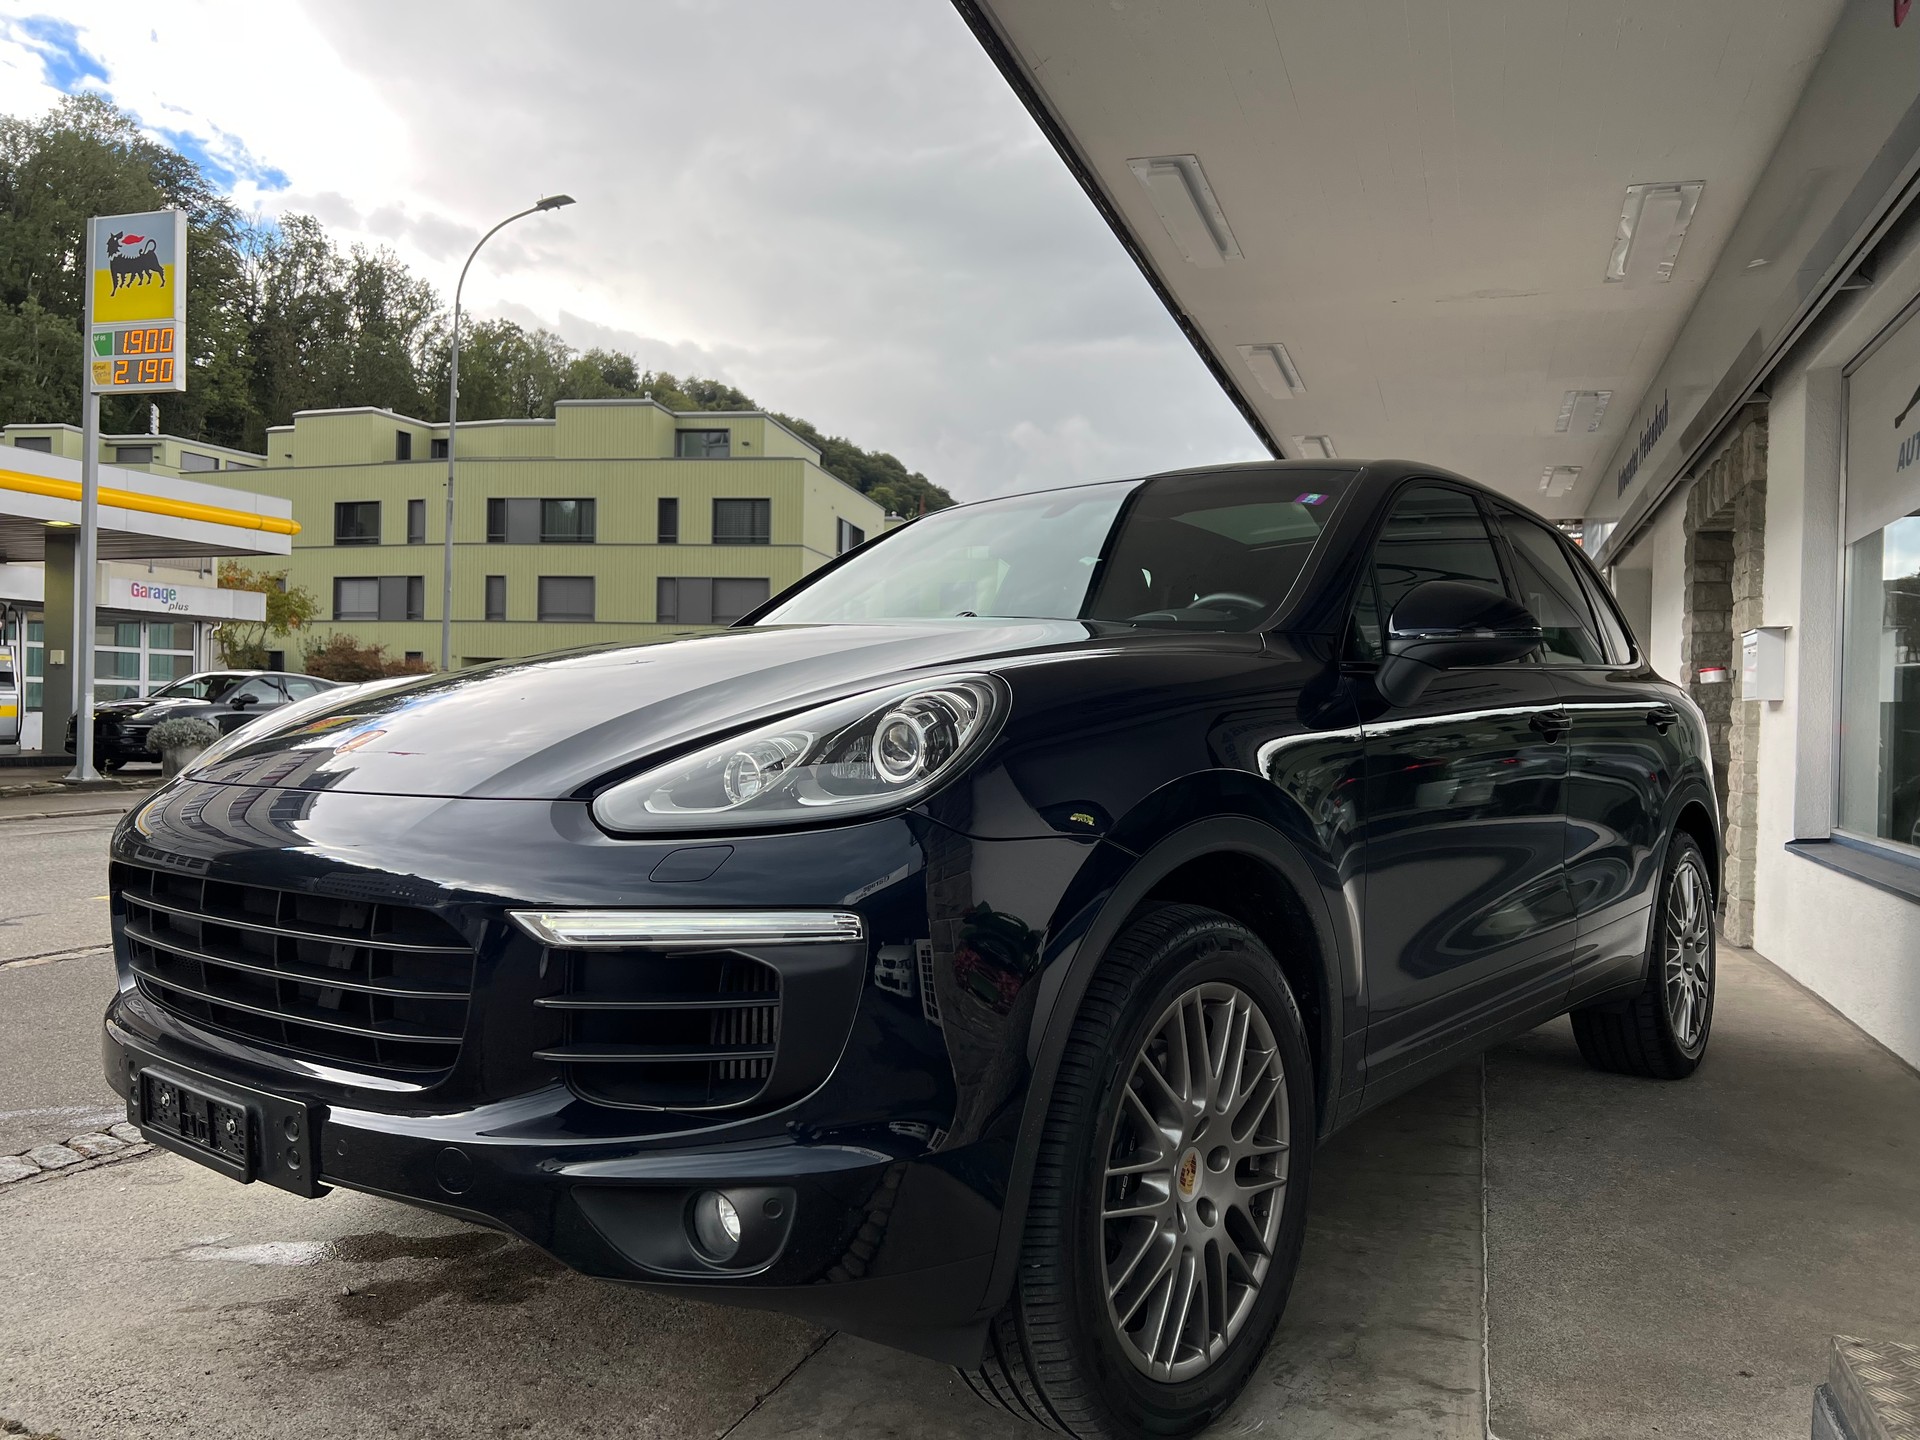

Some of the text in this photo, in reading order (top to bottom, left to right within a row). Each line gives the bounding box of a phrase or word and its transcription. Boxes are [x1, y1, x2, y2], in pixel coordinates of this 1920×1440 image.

[123, 328, 175, 354] 1.900
[114, 358, 174, 384] 2.190
[131, 582, 177, 604] Garage
[168, 602, 189, 611] plus
